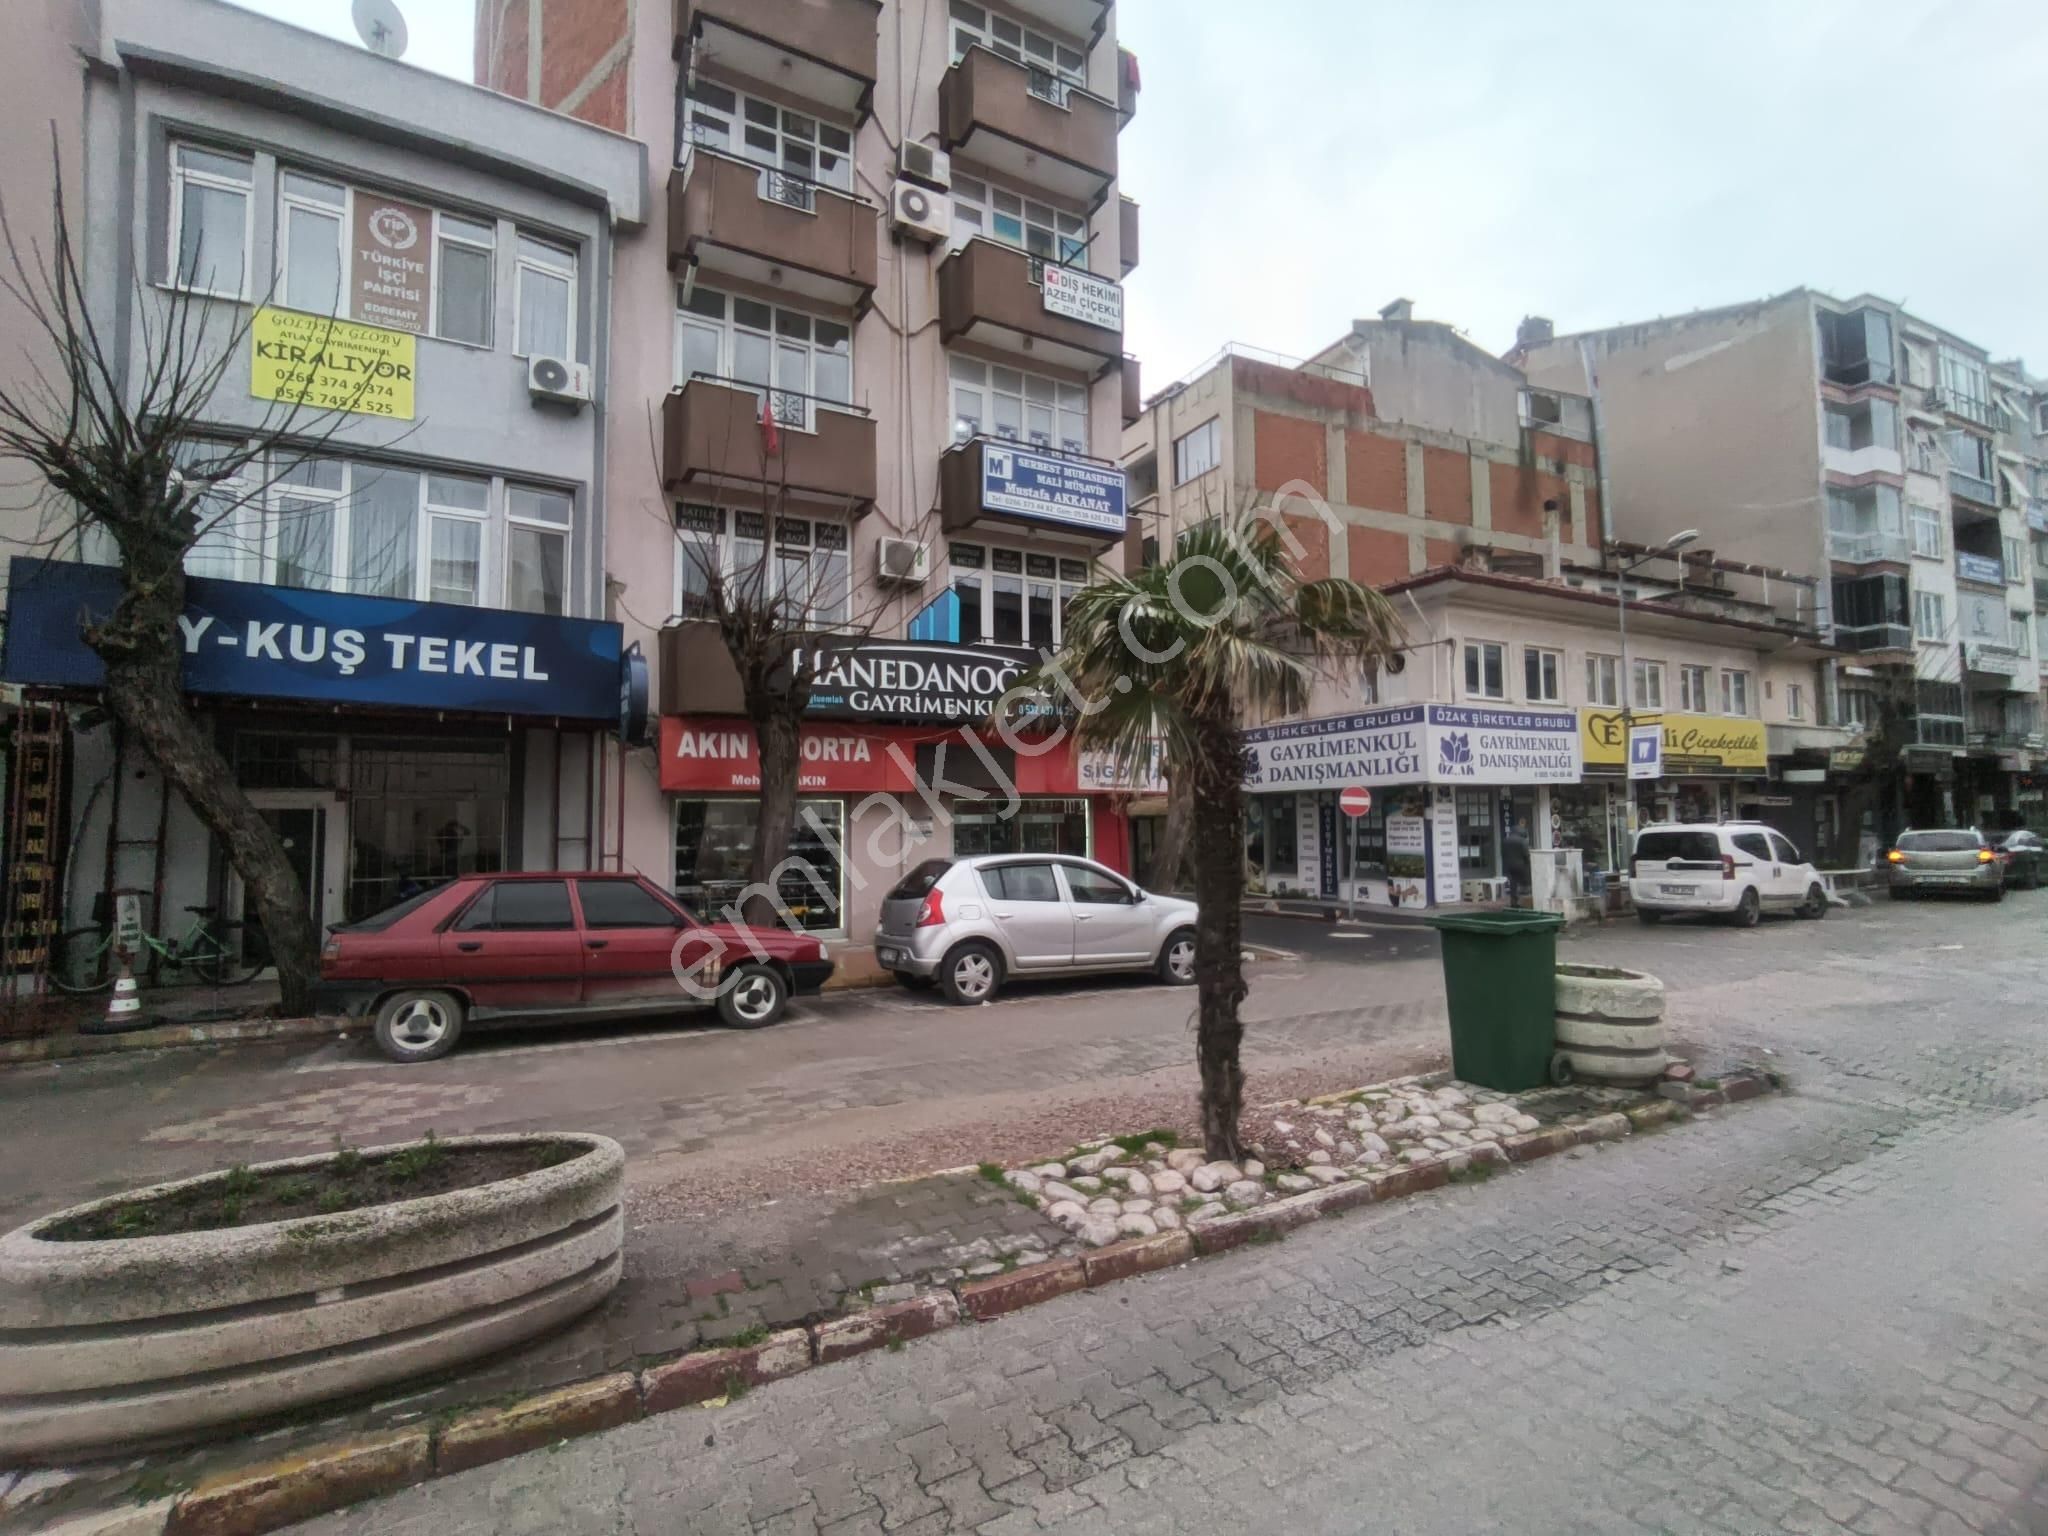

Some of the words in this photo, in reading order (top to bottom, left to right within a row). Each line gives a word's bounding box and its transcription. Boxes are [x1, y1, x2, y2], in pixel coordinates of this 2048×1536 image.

[360, 249, 424, 274] TÜRKİYE
[378, 265, 406, 285] İŞÇİ
[363, 280, 420, 302] PARTİSİ
[1046, 287, 1076, 304] AZEM
[1079, 297, 1121, 319] ÇİÇEKLİ
[1061, 275, 1079, 293] DİŞ
[1082, 282, 1120, 305] HEKİMİ
[364, 302, 418, 321] EDREMİT
[256, 339, 412, 381] KİRALIYOR
[320, 374, 347, 390] 374
[367, 384, 393, 397] 374
[366, 402, 393, 414] 525
[1018, 457, 1062, 474] SERBEST
[1064, 467, 1122, 488] MUHASEBECİ
[1036, 474, 1062, 488] MALİ
[1064, 480, 1106, 497] MÜŞAVİR
[1005, 482, 1051, 501] Mustafa
[1054, 492, 1111, 513] AKKANAT
[383, 632, 549, 681] TEKEL
[1267, 721, 1347, 740] ŞİRKETLER
[1353, 711, 1414, 728] GRUBU
[1436, 708, 1467, 722] ÖZAK
[1472, 711, 1531, 727] ŞİRKETLER
[1535, 717, 1571, 728] GRUBU
[676, 732, 748, 759] AKIN
[1270, 731, 1417, 762] GAYRİMENKUL
[1480, 732, 1571, 751] GAYRİMENKUL
[1681, 728, 1759, 754] Çiçekçilik
[1269, 752, 1421, 784] DANIŞMANLIĞI
[1480, 753, 1572, 772] DANIŞMANLIĞI
